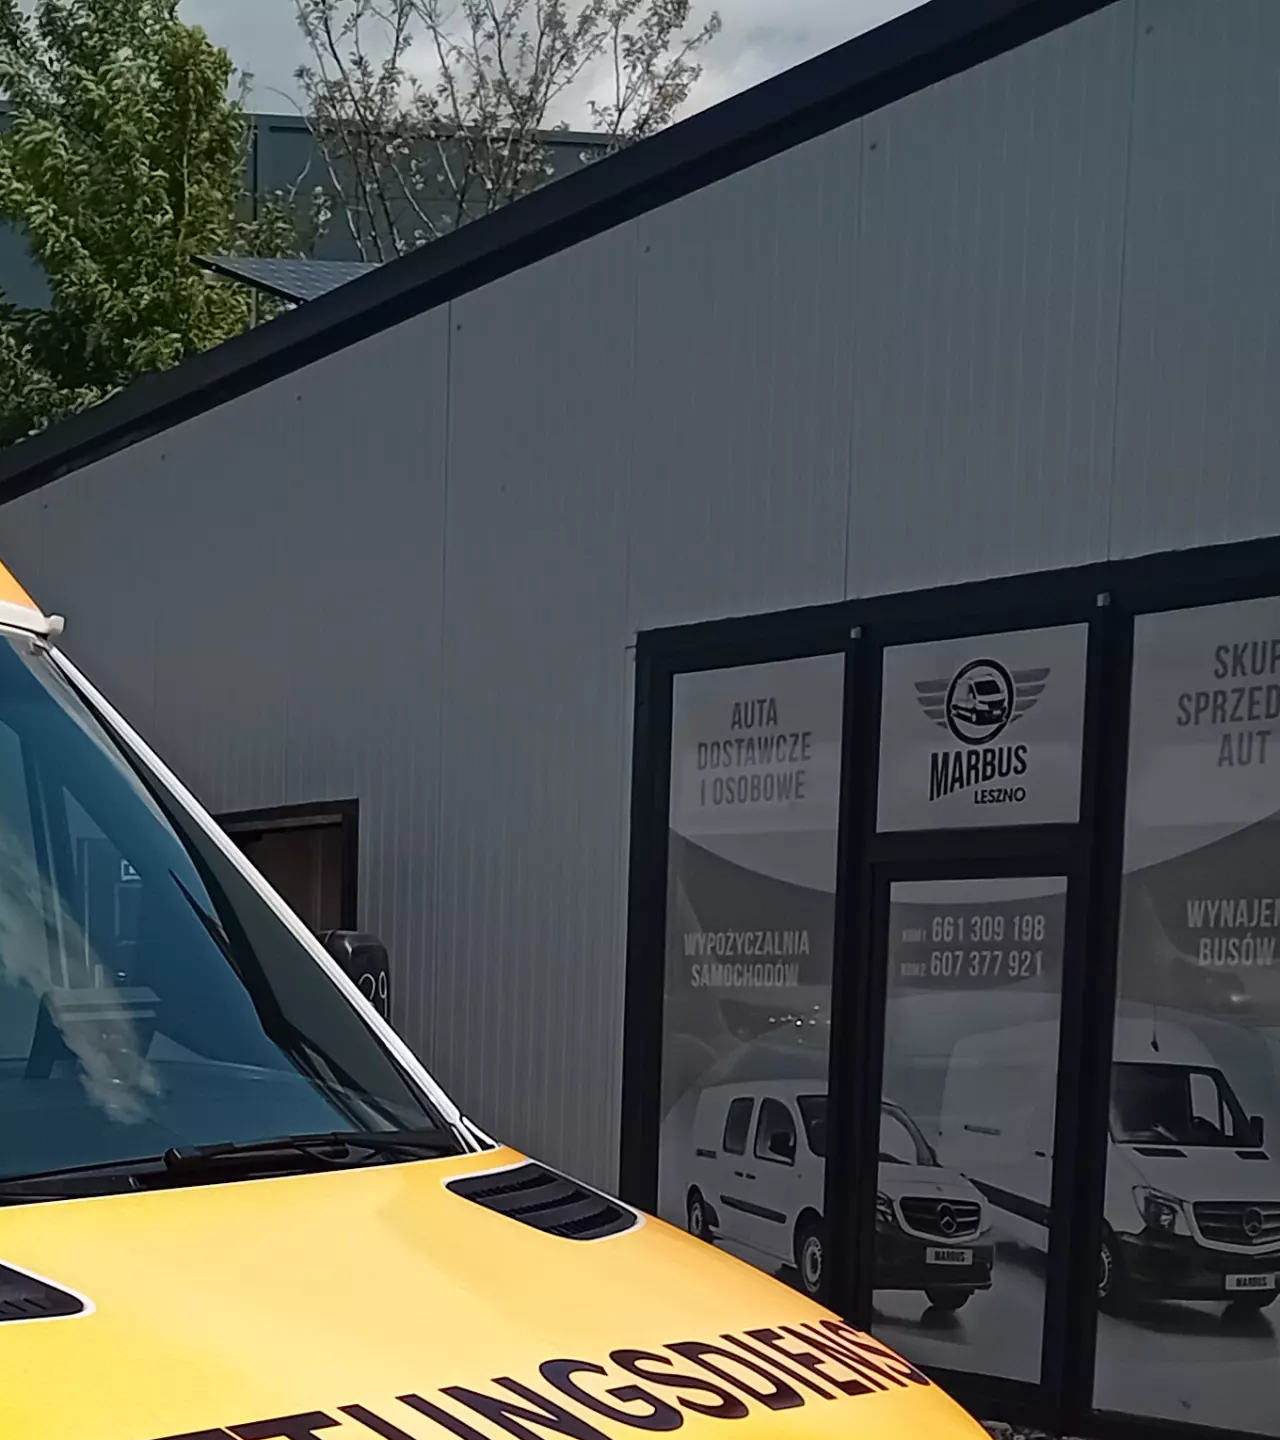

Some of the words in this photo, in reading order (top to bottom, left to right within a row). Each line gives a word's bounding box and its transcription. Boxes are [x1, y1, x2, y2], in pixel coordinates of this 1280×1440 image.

[731, 697, 779, 730] AUTA
[696, 731, 813, 771] DOSTAWCZE
[1216, 729, 1273, 768] AUT
[700, 779, 706, 806] I
[712, 769, 806, 806] OSOBOWE
[928, 744, 1028, 802] MARBUS
[973, 786, 1027, 805] LESZNO
[683, 928, 810, 956] WYPOŻYCZALNIA
[932, 916, 964, 942] 661
[970, 915, 1005, 941] 309
[1013, 914, 1045, 941] 198
[931, 951, 964, 977] 607
[968, 950, 1003, 977] 377
[1008, 950, 1043, 977] 921
[1198, 931, 1276, 967] BUSÓW
[690, 960, 800, 988] SAMOCHODÓW
